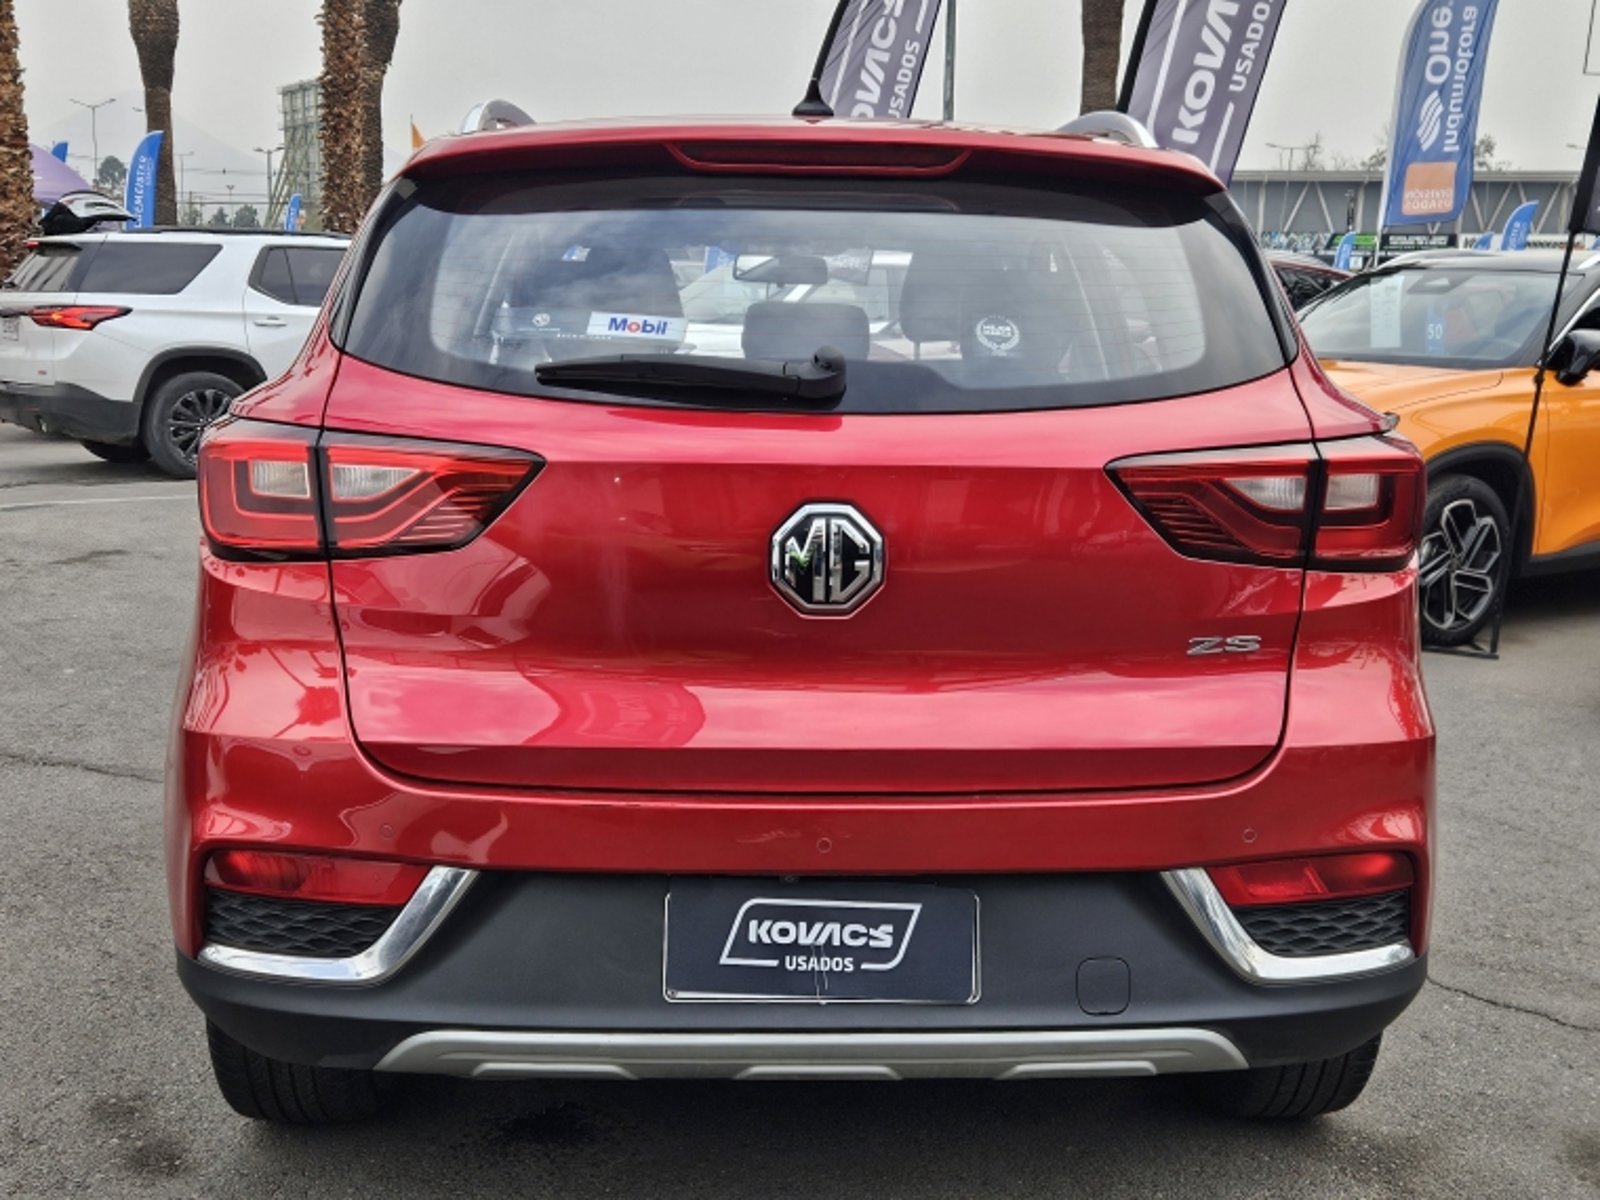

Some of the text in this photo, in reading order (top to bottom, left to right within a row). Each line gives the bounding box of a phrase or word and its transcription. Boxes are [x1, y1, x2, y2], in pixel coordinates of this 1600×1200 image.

[608, 317, 669, 335] Mobil
[784, 517, 870, 603] MG
[1186, 635, 1262, 655] ZS
[748, 919, 894, 949] KOVACS
[784, 955, 854, 973] USADOS
